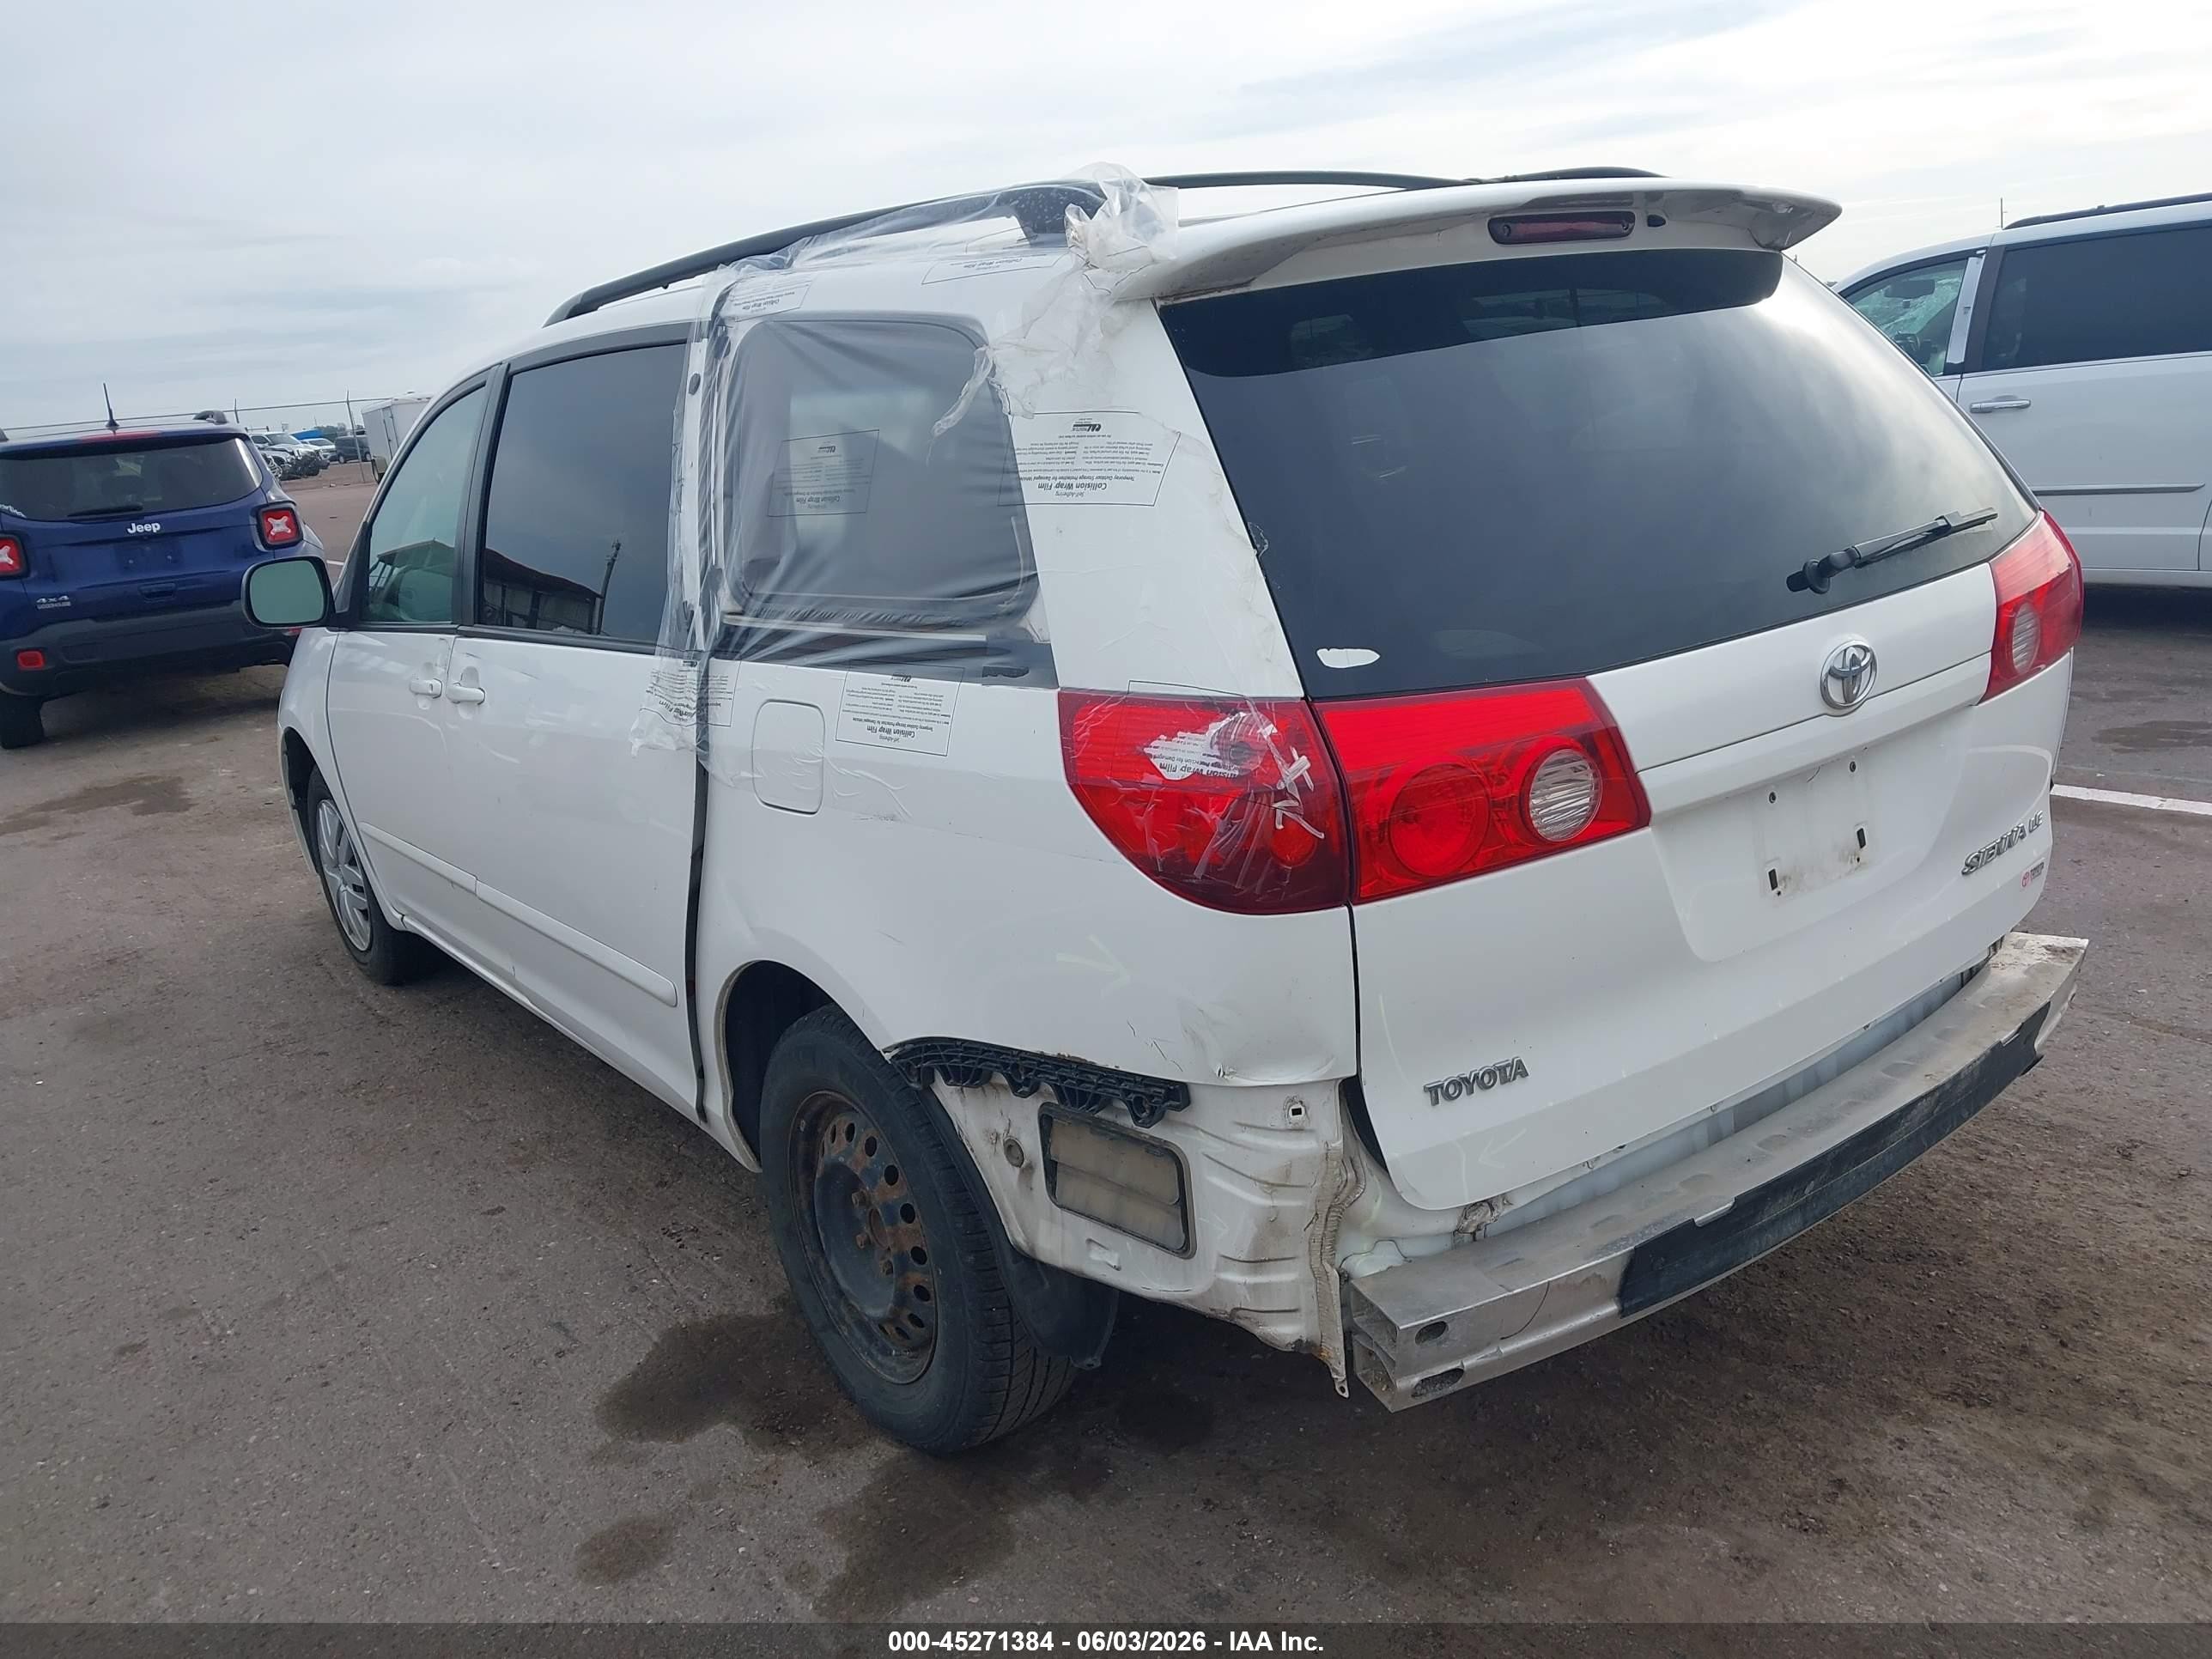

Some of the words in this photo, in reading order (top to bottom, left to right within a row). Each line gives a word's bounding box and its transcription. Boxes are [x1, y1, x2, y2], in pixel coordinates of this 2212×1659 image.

[1037, 483, 1053, 491] Film
[1055, 481, 1074, 490] Wrap
[1075, 483, 1107, 491] Collision
[127, 522, 161, 534] Jeep
[36, 595, 70, 604] 4x4
[878, 726, 892, 736] Wrap
[893, 729, 915, 738] Collision
[1159, 763, 1177, 773] Film
[1961, 823, 2027, 875] SIENNA
[2028, 810, 2044, 833] LE
[1424, 1056, 1529, 1107] TOYOTA
